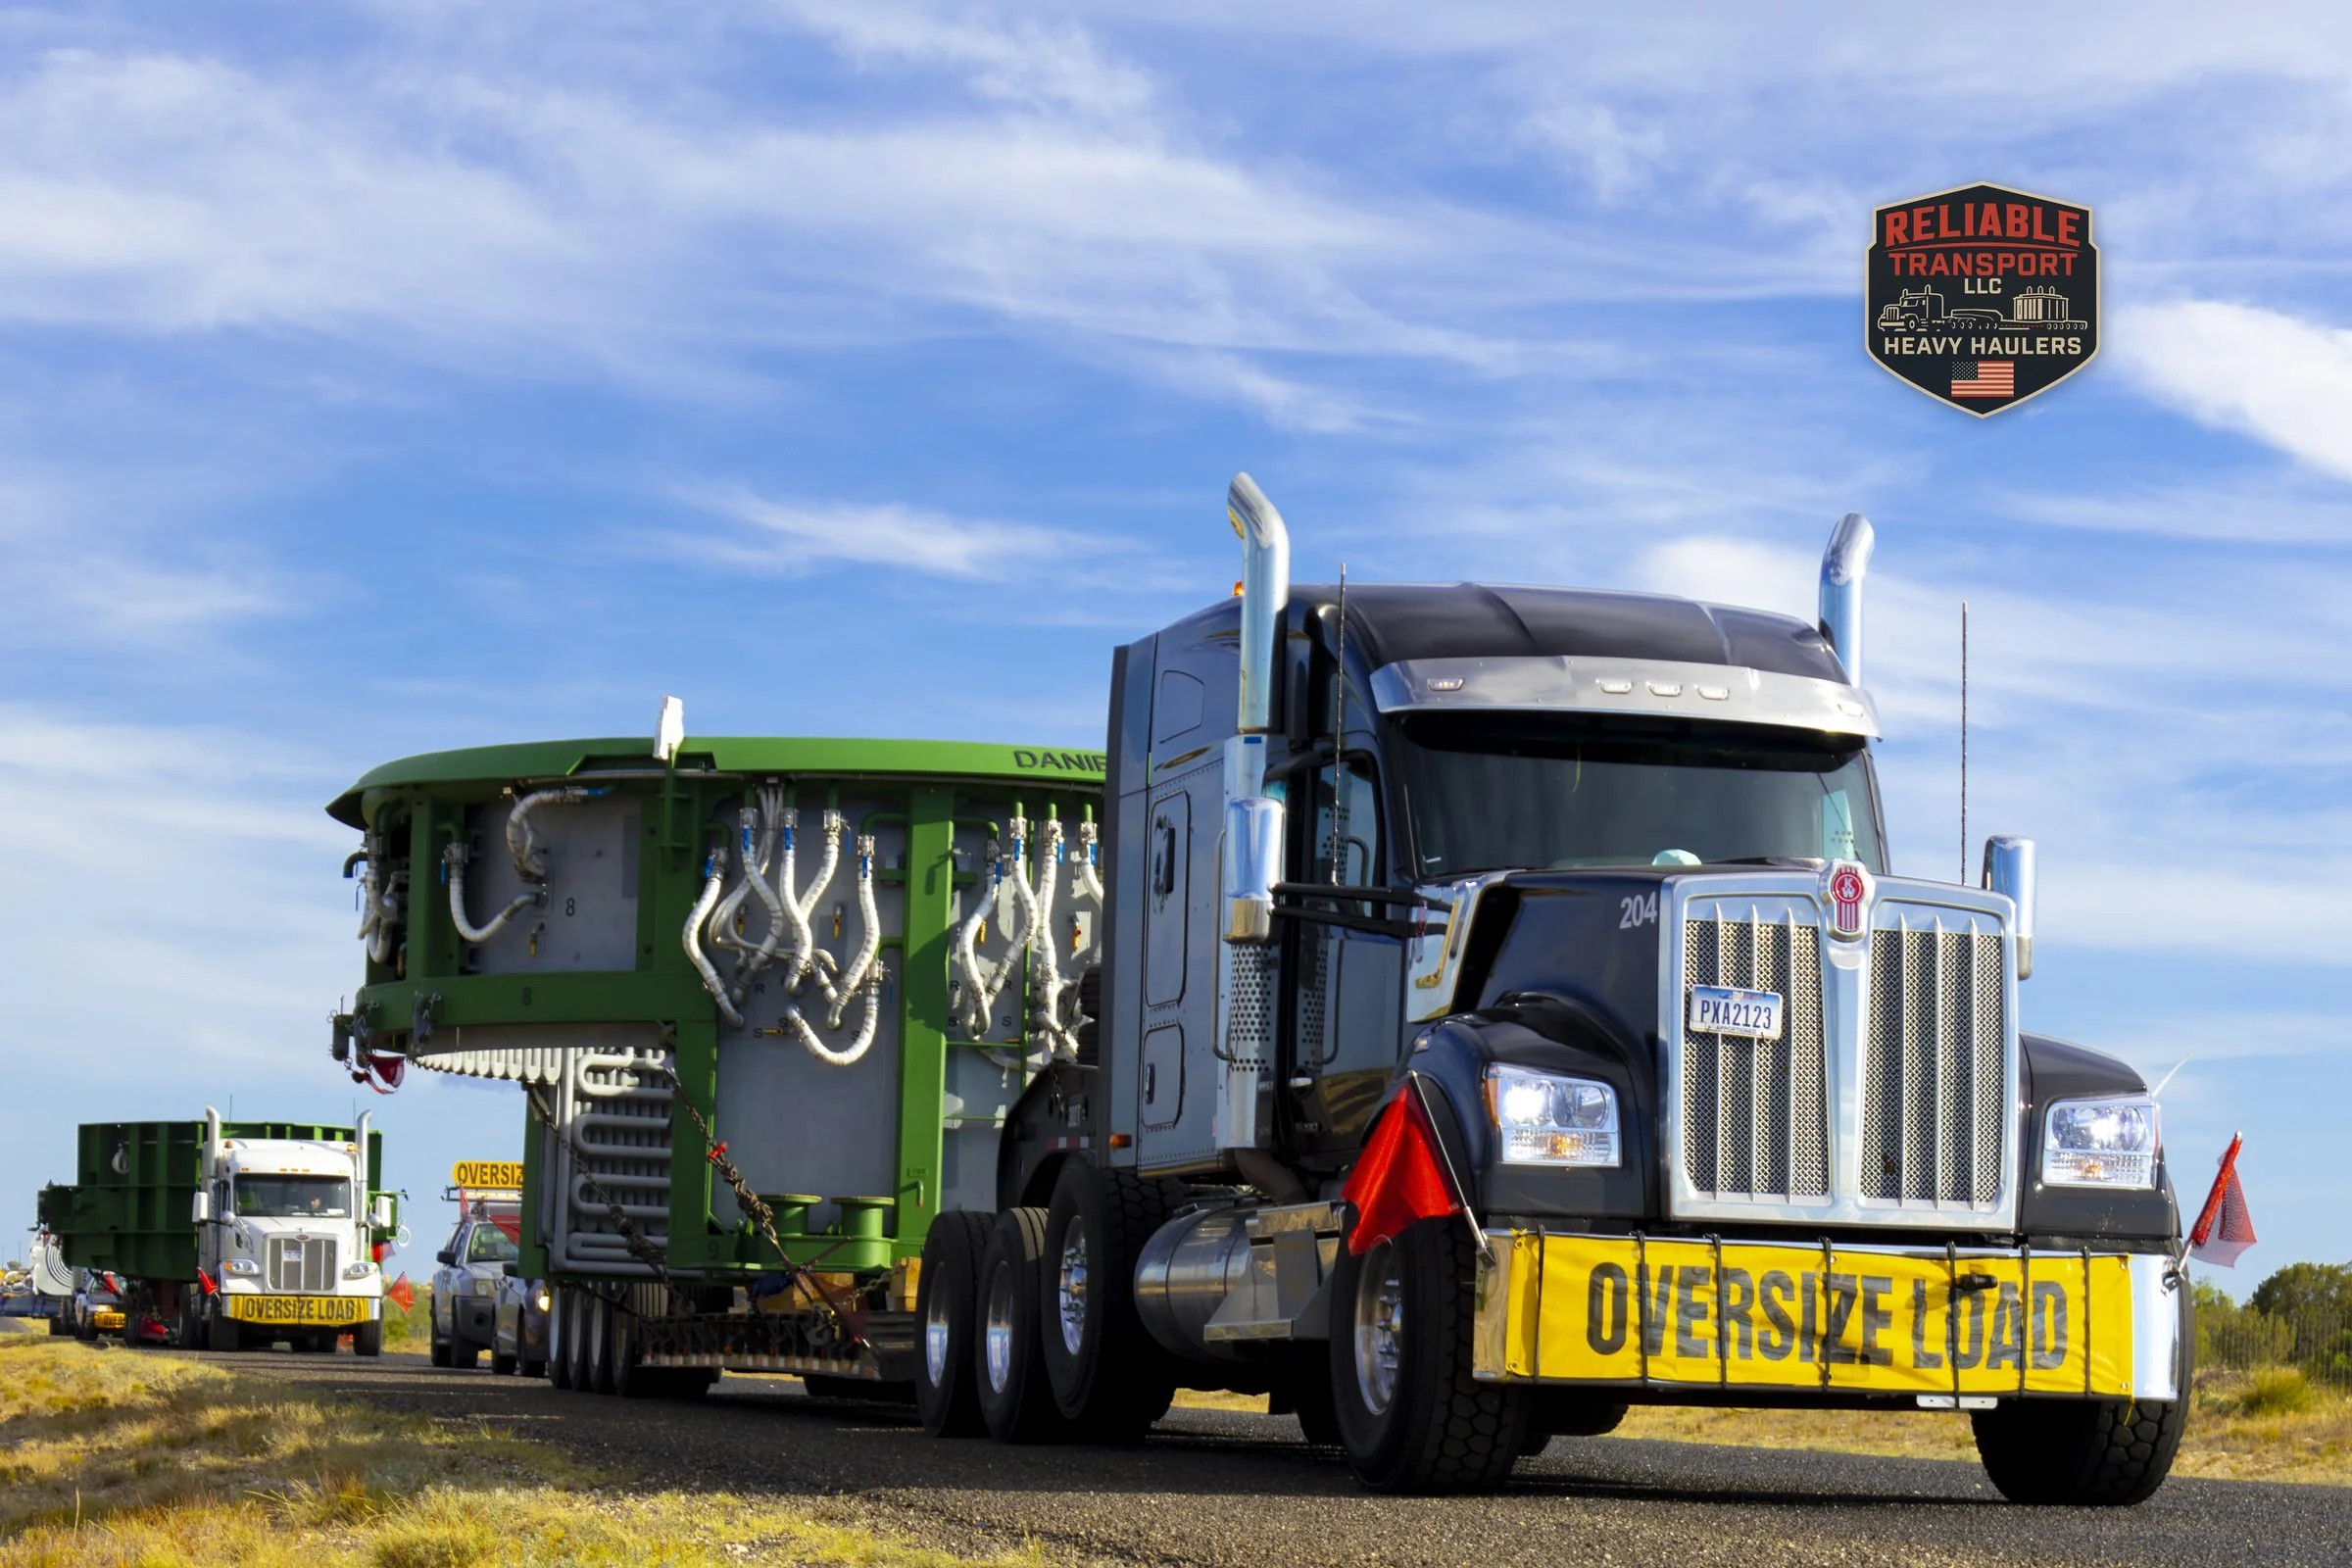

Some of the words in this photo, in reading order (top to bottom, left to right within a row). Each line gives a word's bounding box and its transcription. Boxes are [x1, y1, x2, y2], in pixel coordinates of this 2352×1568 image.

[565, 897, 575, 917] 8
[1619, 891, 1658, 929] 204
[1700, 1000, 1772, 1030] PXA2123
[1716, 1025, 1757, 1035] APPORTIONED
[245, 1298, 315, 1320] OVERSIZE
[318, 1299, 356, 1320] LOAD
[1587, 1261, 1893, 1365] OVERSIZE
[1912, 1278, 2069, 1370] LOAD
